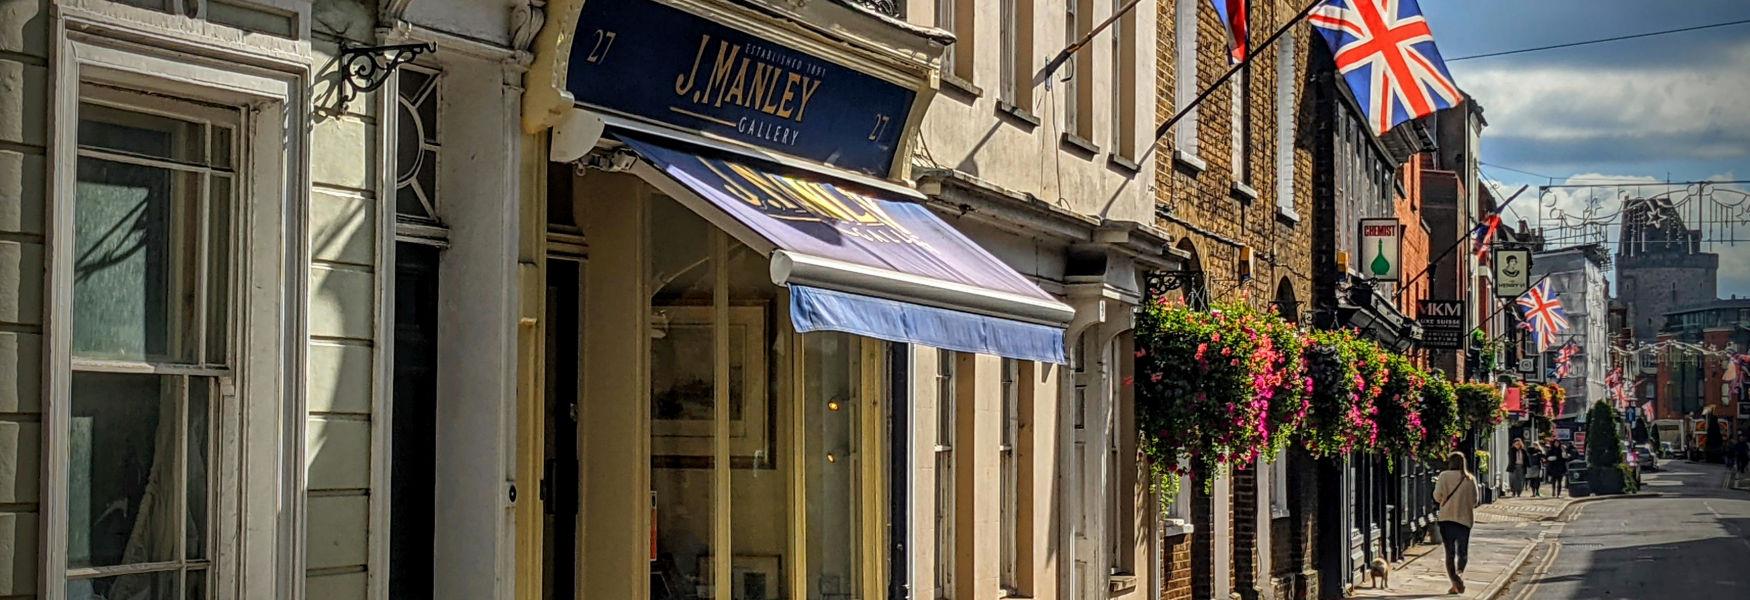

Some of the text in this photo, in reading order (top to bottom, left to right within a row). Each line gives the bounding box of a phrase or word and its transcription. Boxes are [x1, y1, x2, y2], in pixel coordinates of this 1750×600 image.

[586, 29, 617, 65] 27
[745, 43, 801, 70] ESTABLISHED
[738, 116, 799, 146] GALLERY
[868, 113, 890, 142] 27
[1364, 225, 1395, 236] CHEMIST
[1417, 302, 1461, 316] MKM
